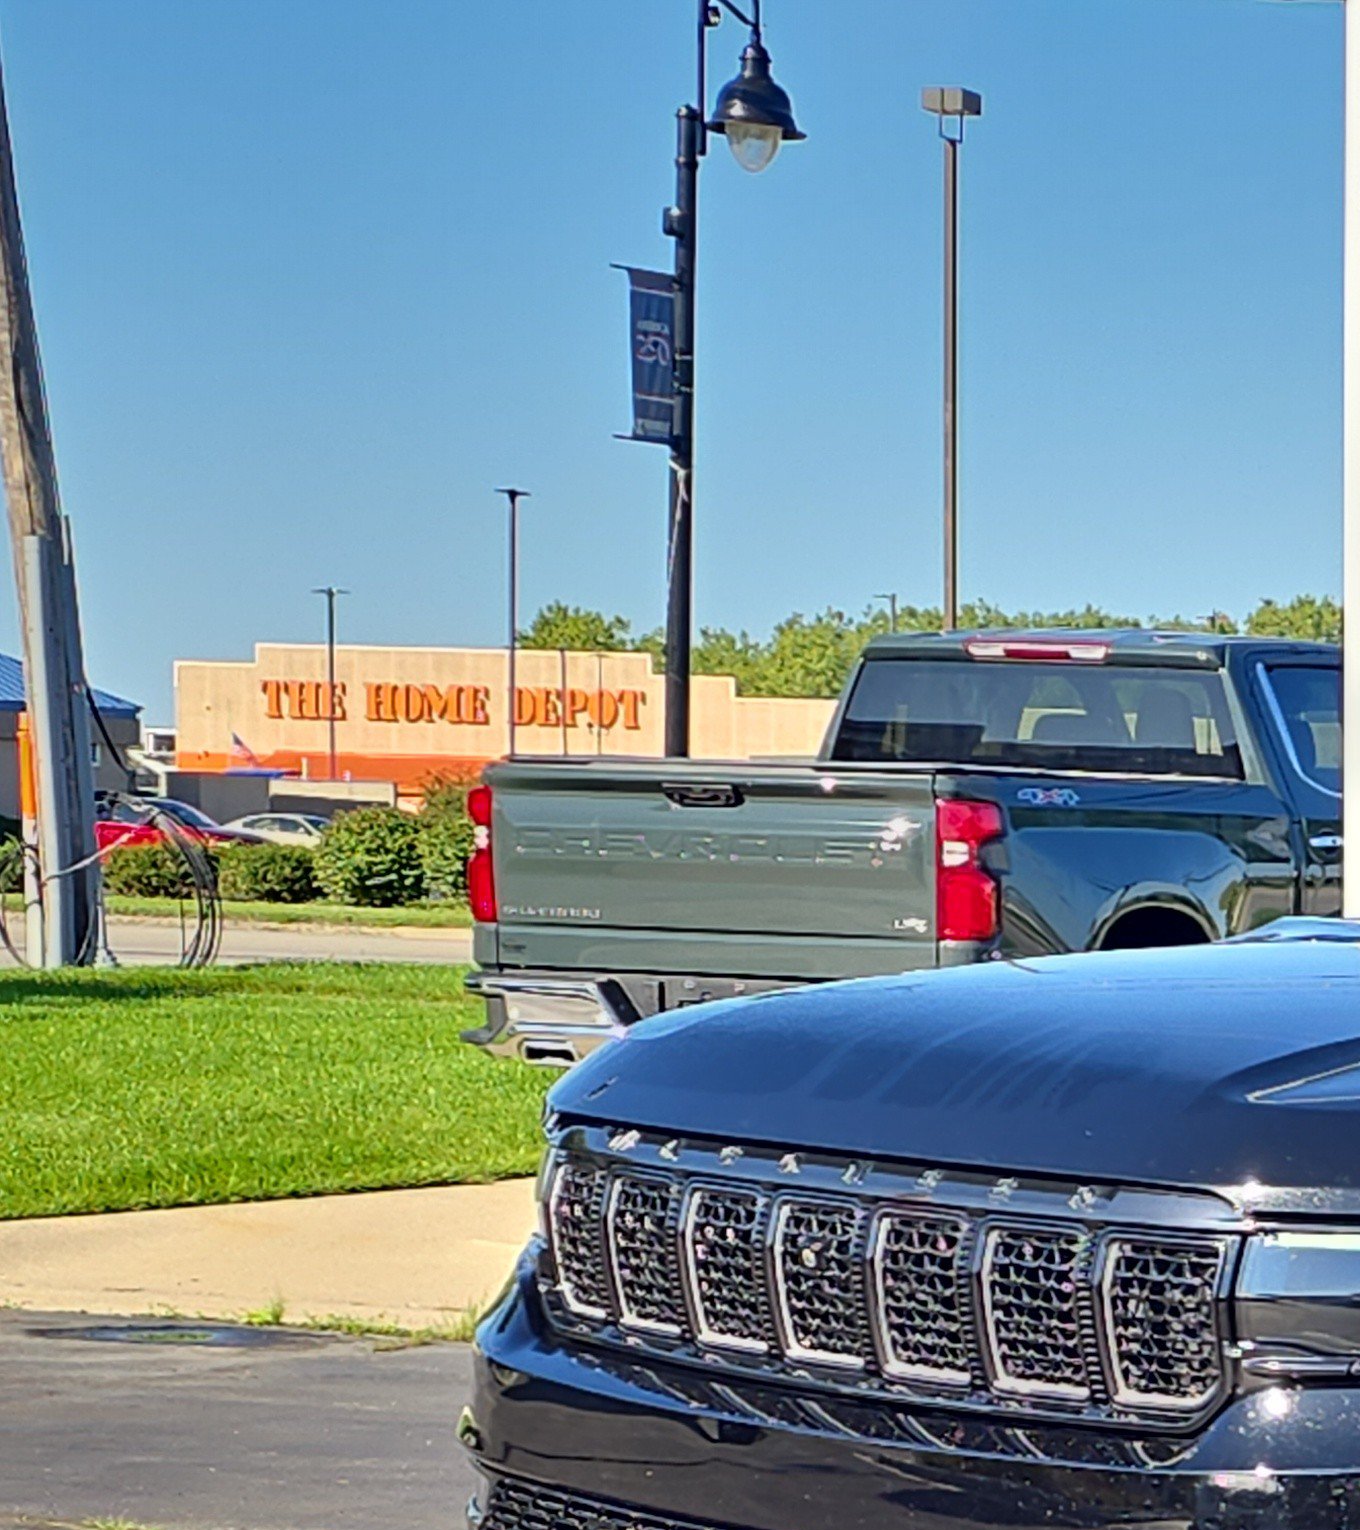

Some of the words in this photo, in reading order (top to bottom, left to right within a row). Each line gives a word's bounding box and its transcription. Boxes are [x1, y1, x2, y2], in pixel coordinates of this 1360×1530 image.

[261, 680, 347, 720] THE
[364, 682, 490, 725] HOME
[509, 686, 646, 730] DEPOT
